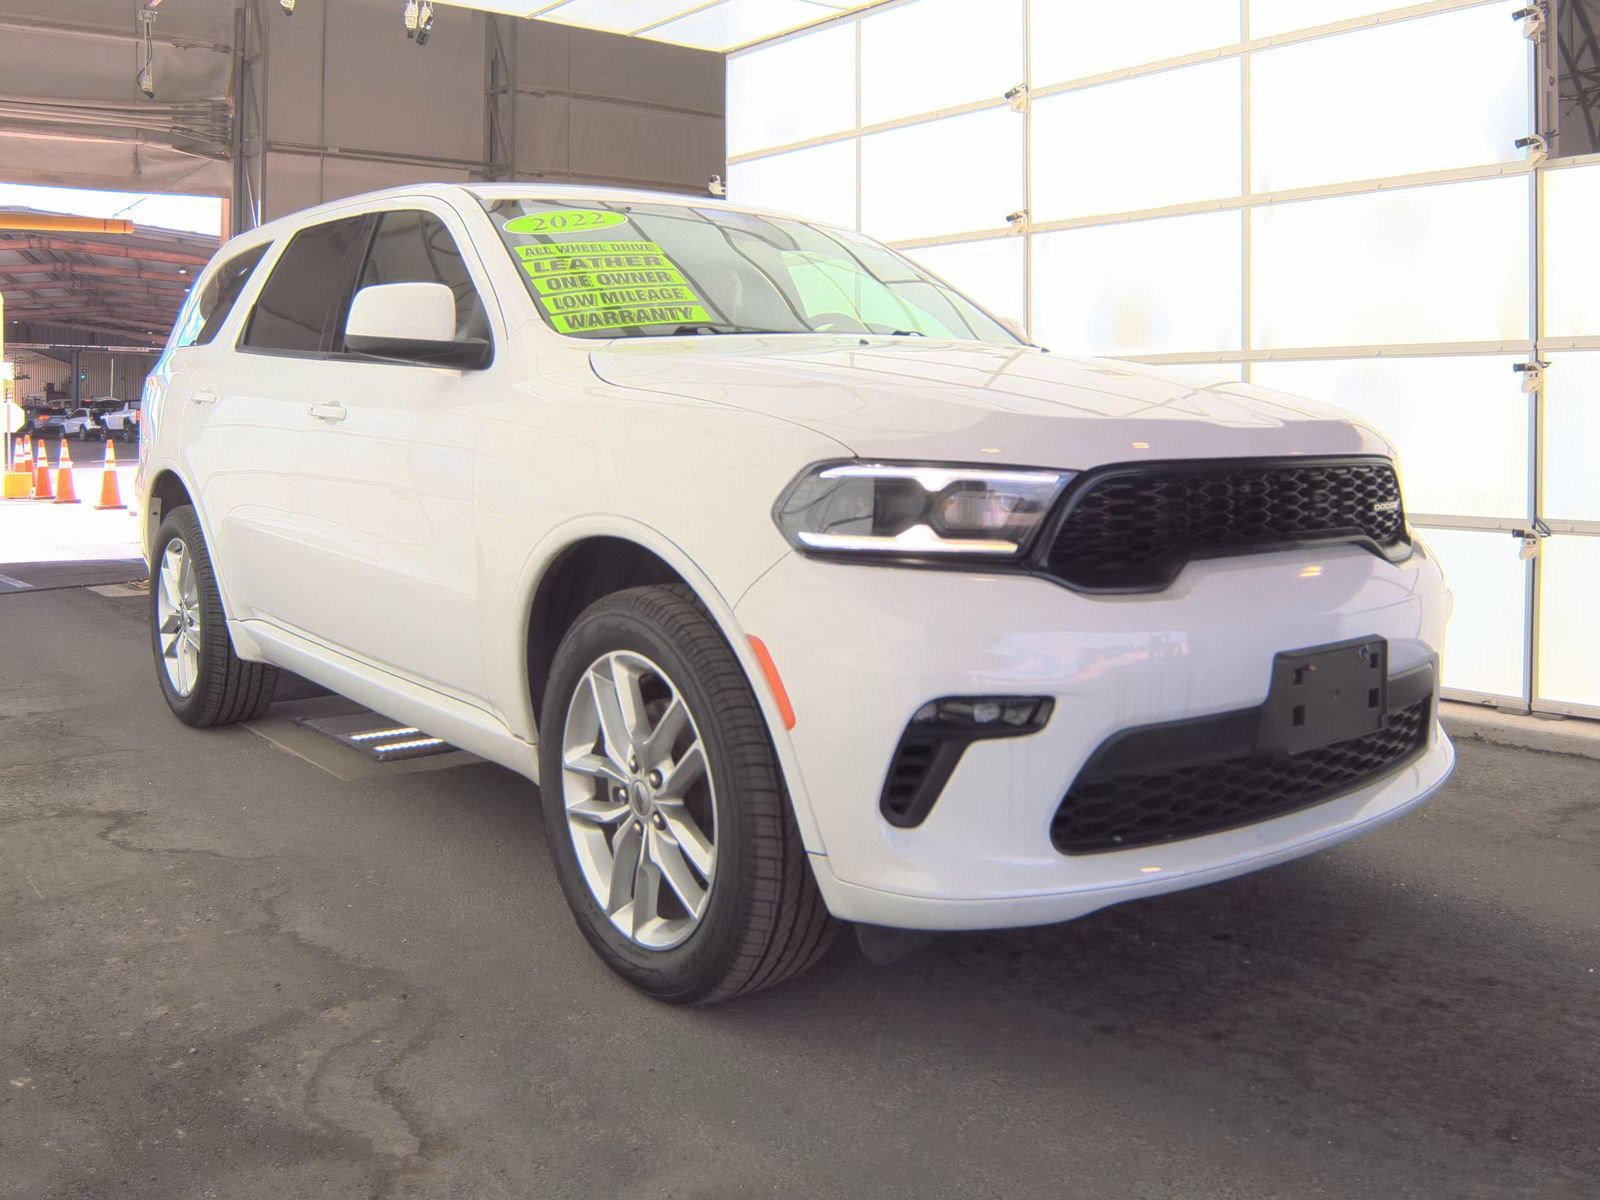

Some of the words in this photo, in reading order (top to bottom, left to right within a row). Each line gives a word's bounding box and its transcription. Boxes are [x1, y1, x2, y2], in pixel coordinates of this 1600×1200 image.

[533, 212, 606, 231] 2022
[525, 246, 552, 257] ALL
[556, 243, 606, 254] WHEEL
[610, 241, 655, 252] DRIVE
[533, 256, 662, 273] LEATHER
[546, 274, 591, 291] ONE
[597, 271, 672, 285] OWNER
[552, 294, 598, 310] LOW
[601, 287, 686, 304] MILEAGE
[564, 306, 693, 330] WARRANTY
